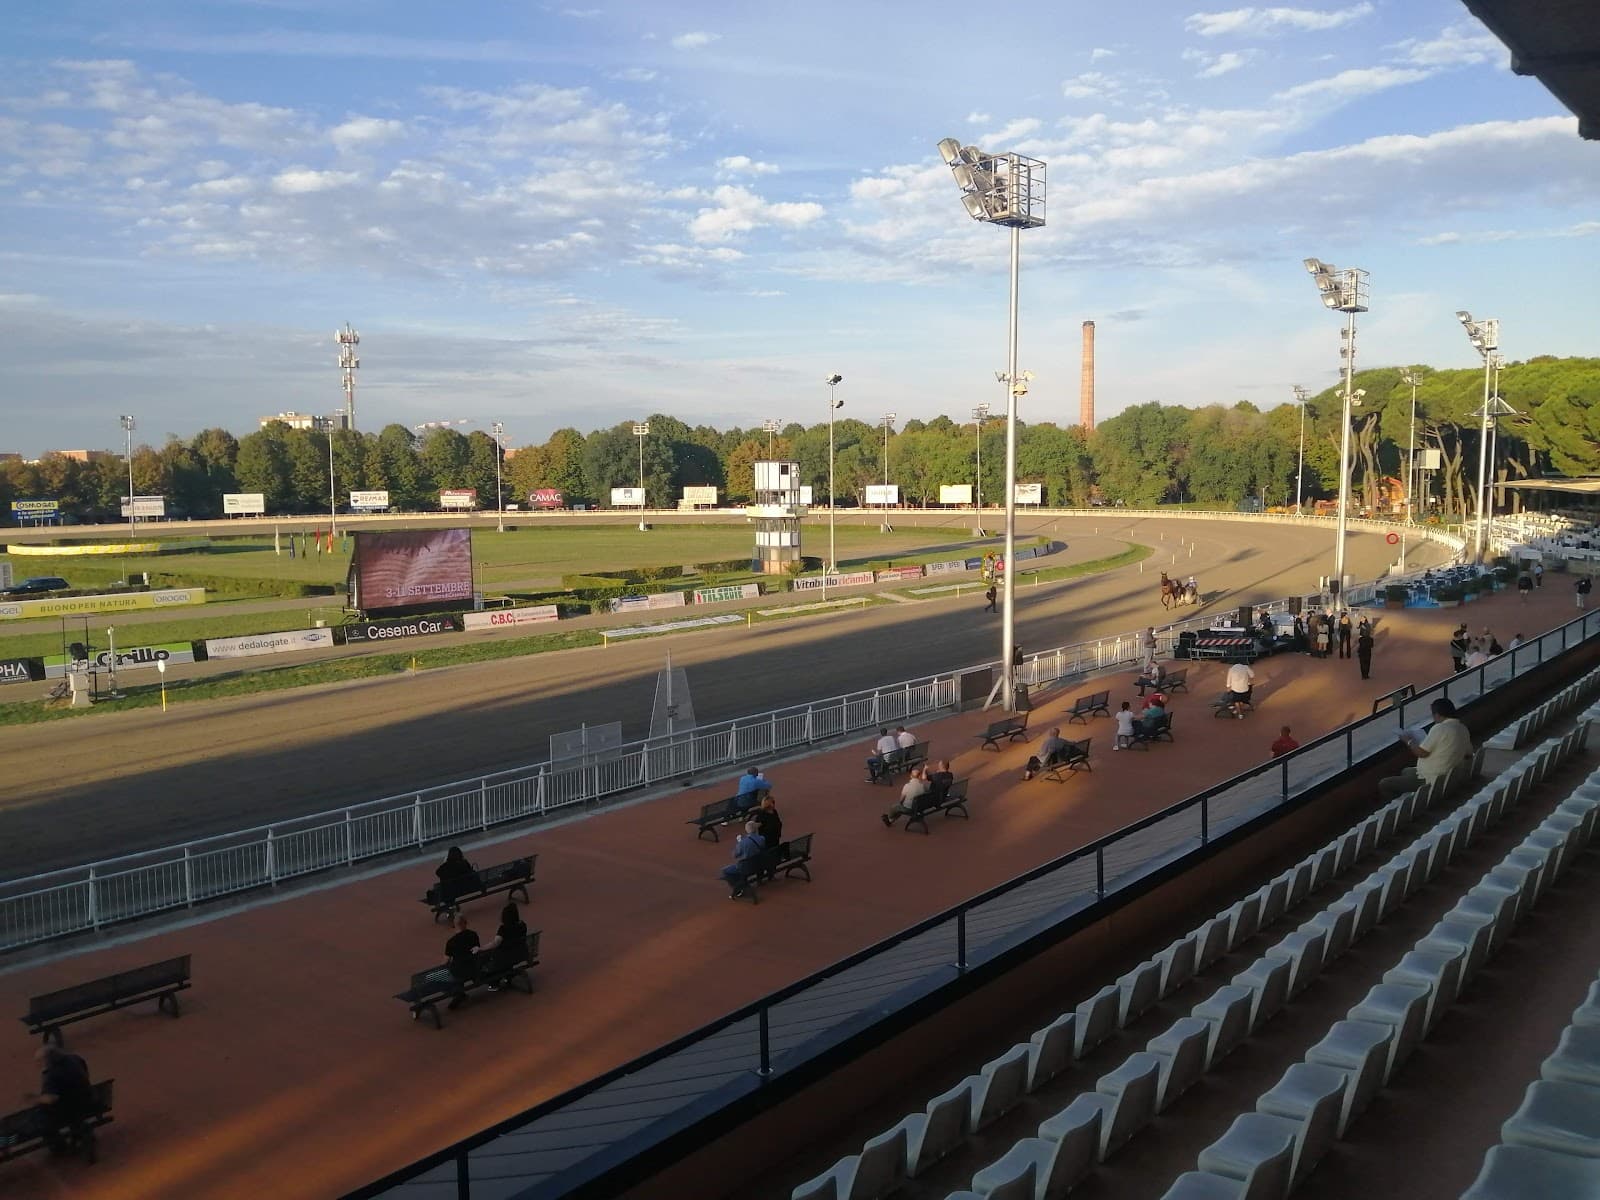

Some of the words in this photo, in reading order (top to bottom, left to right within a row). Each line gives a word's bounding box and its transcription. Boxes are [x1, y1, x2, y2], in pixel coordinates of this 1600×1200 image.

[529, 493, 561, 502] CAMAC
[408, 581, 470, 596] SETTEMBRE
[40, 604, 76, 613] BUONO
[100, 599, 137, 608] NATURA
[367, 624, 418, 639] Cesena
[419, 620, 442, 634] Car
